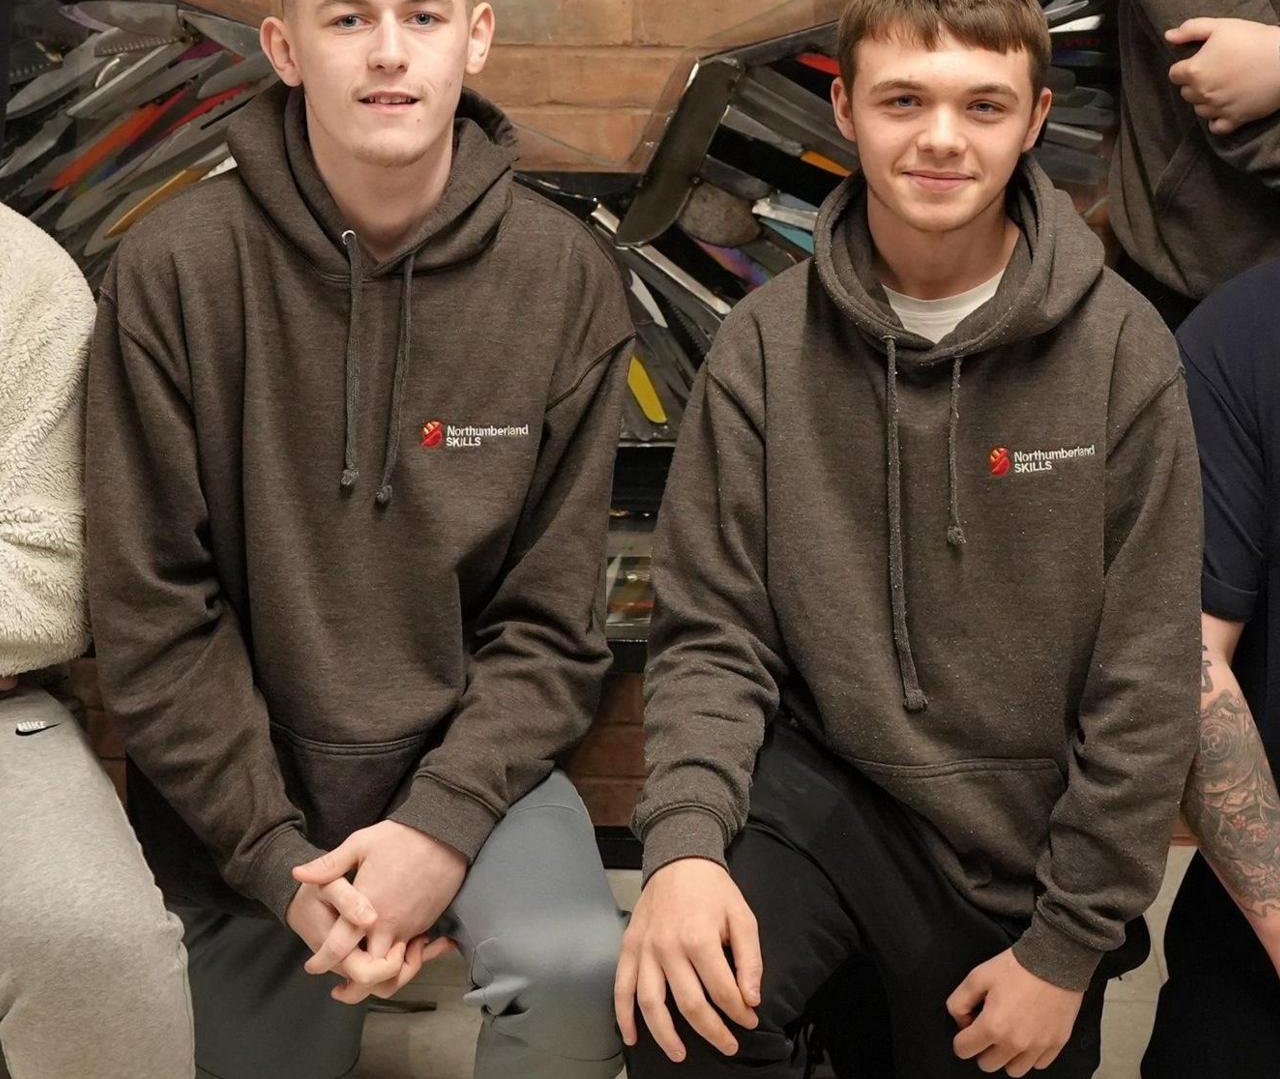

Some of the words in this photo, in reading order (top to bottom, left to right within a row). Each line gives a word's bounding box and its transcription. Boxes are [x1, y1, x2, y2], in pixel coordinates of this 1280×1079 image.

[446, 424, 529, 437] Northumberland
[446, 436, 482, 447] SKILLS
[1014, 445, 1096, 463] Northumberland
[1014, 461, 1053, 473] SKILLS
